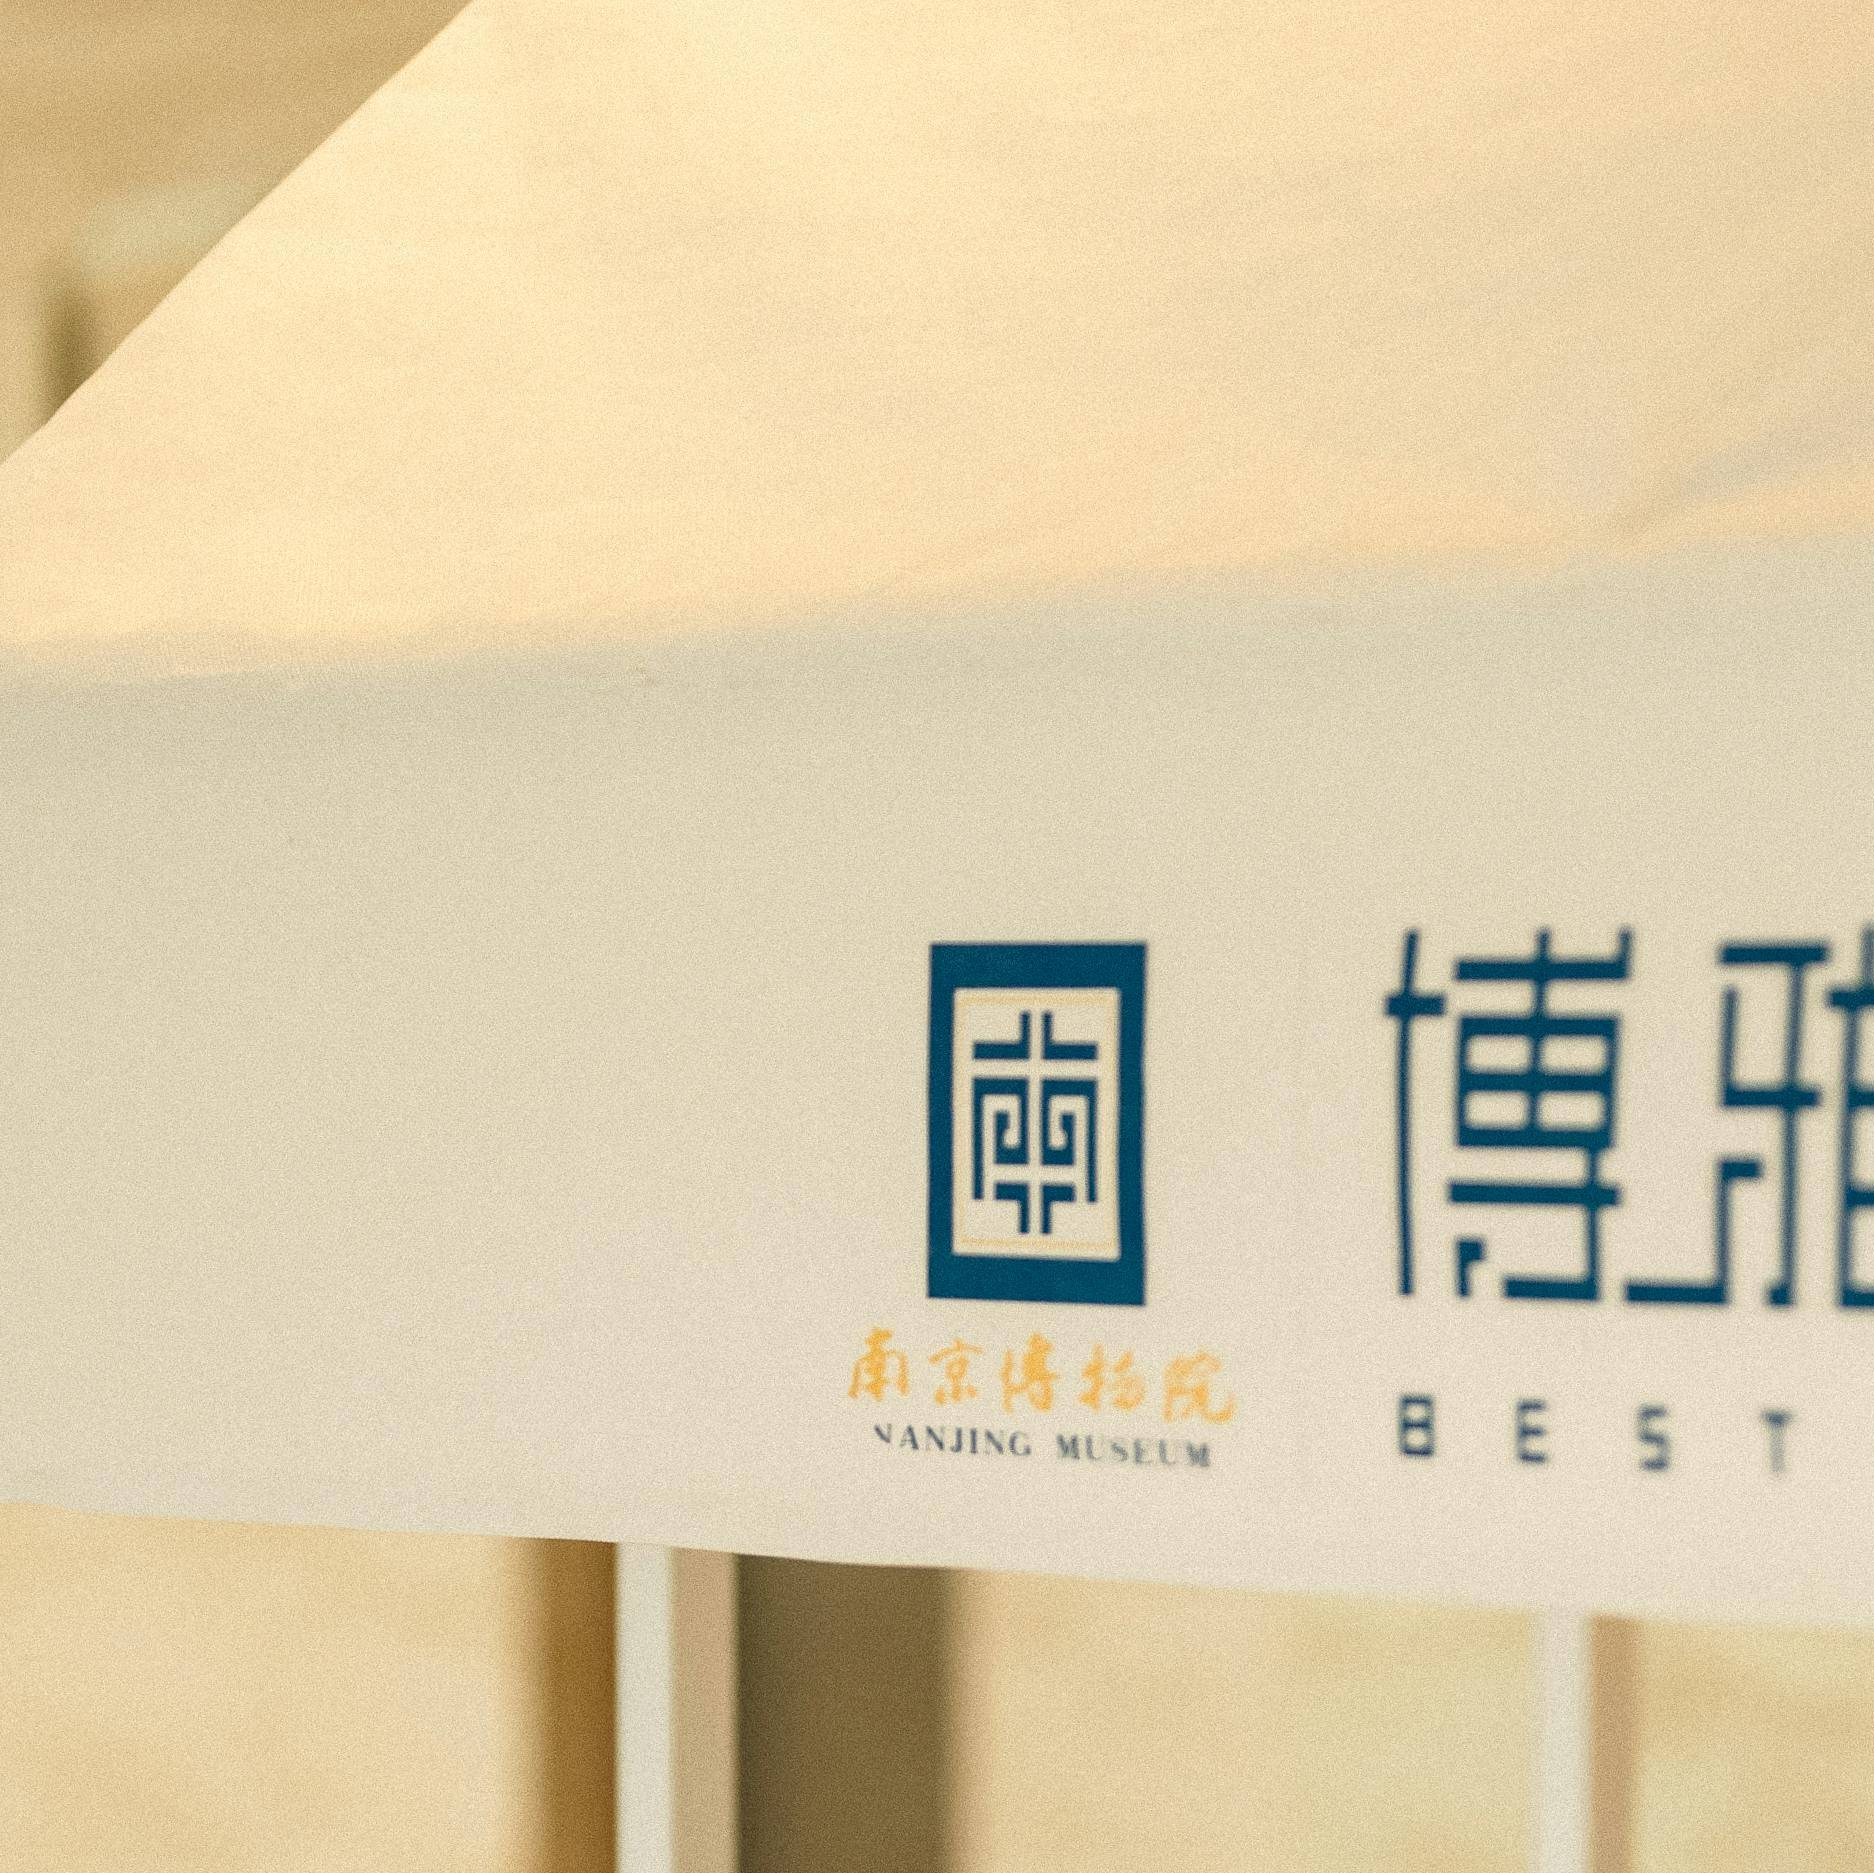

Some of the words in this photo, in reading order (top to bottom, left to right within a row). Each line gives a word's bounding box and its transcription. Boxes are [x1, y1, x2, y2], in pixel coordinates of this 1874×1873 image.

[847, 1327, 1237, 1426] 南京博物院
[873, 1423, 1033, 1458] NANJING
[1056, 1432, 1211, 1470] MUSEUM
[1399, 1394, 1792, 1474] BEST
